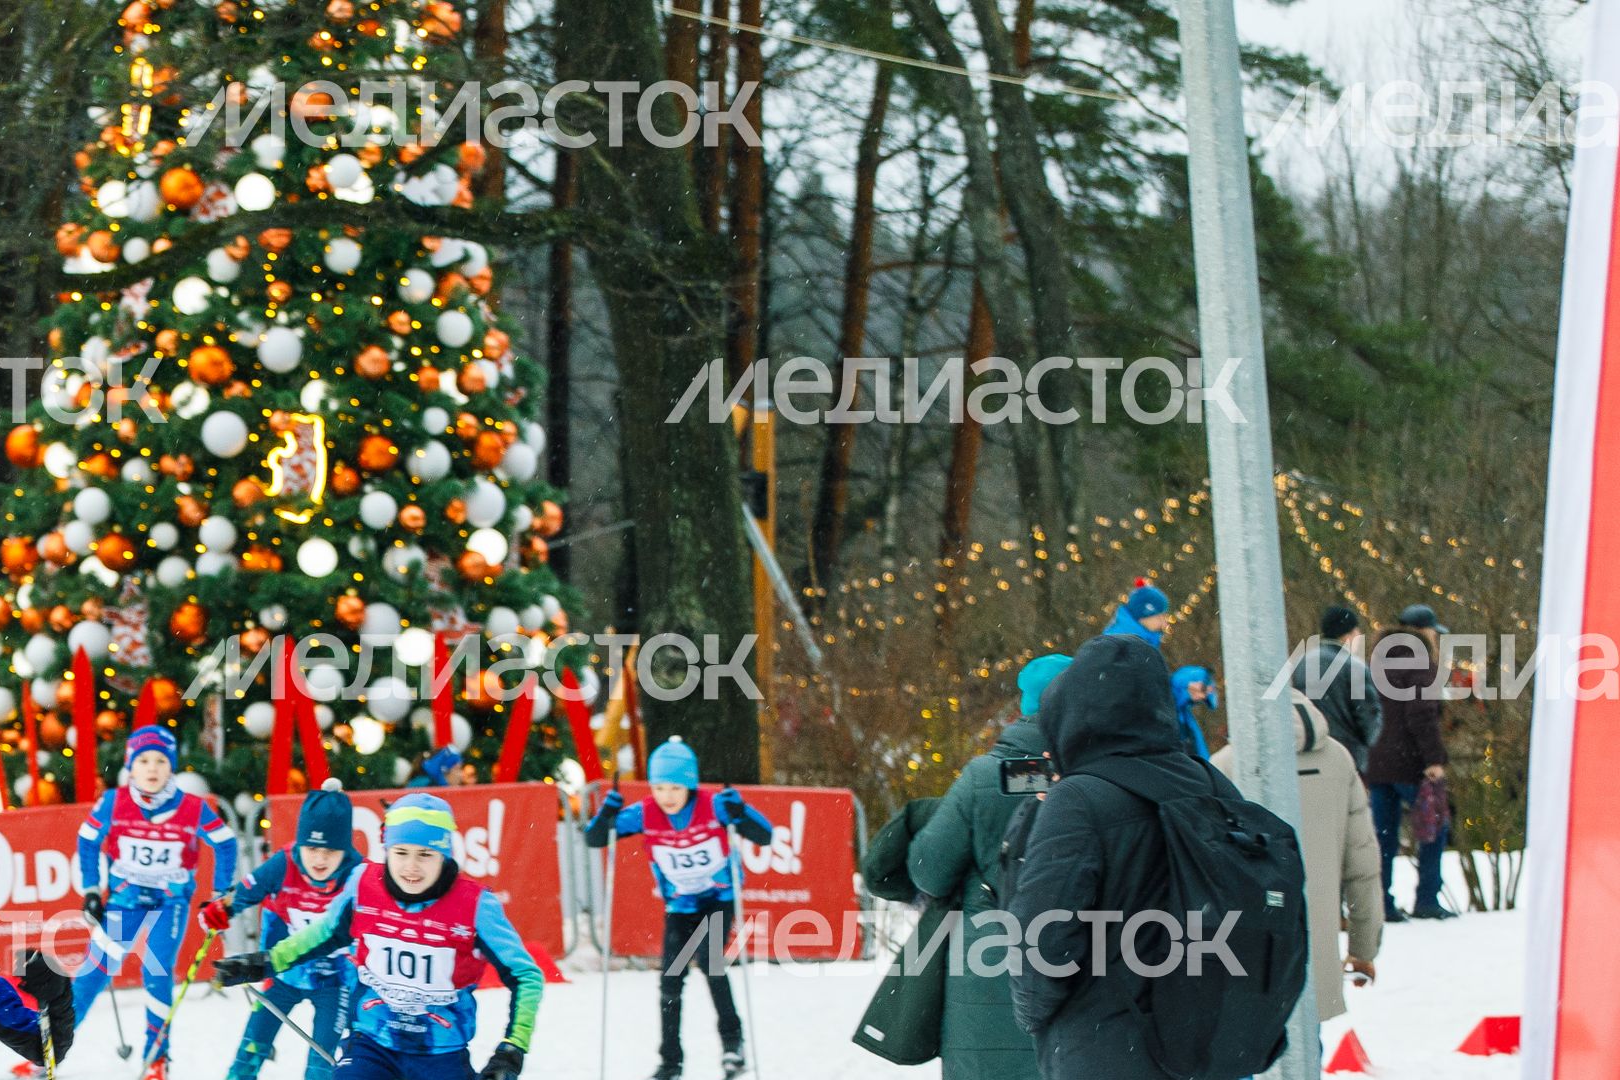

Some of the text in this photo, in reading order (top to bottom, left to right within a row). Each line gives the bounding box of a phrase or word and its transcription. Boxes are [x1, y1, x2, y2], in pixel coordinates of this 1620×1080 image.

[131, 844, 170, 866] 134
[668, 849, 711, 869] 133
[381, 946, 432, 985] 101
